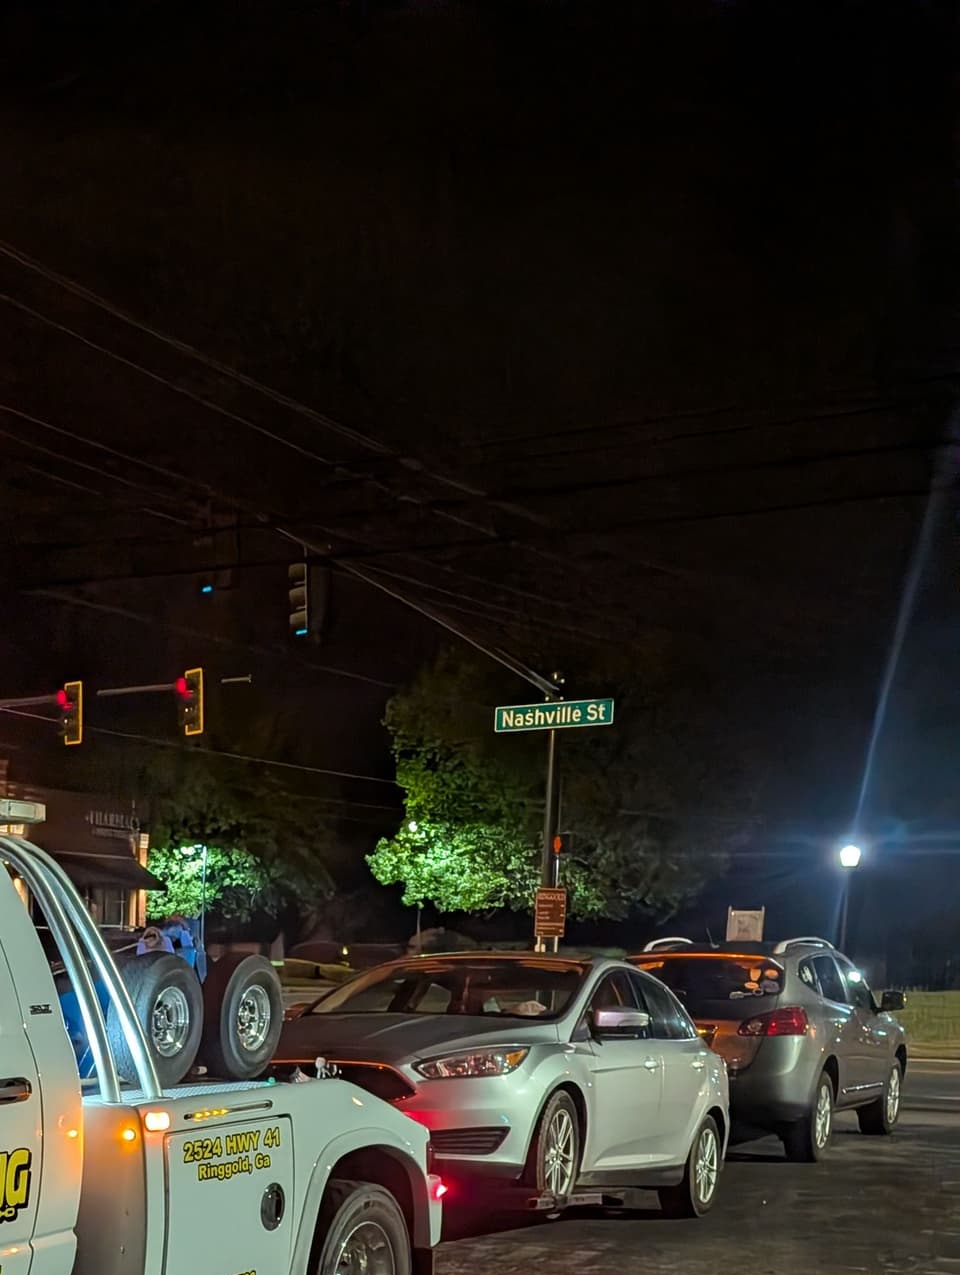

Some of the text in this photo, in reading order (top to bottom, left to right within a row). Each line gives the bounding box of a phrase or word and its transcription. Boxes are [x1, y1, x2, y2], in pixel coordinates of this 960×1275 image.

[502, 703, 606, 728] Nashville St
[183, 1126, 281, 1164] 2524 HWY 41
[198, 1152, 271, 1181] Ringgold, Ga
